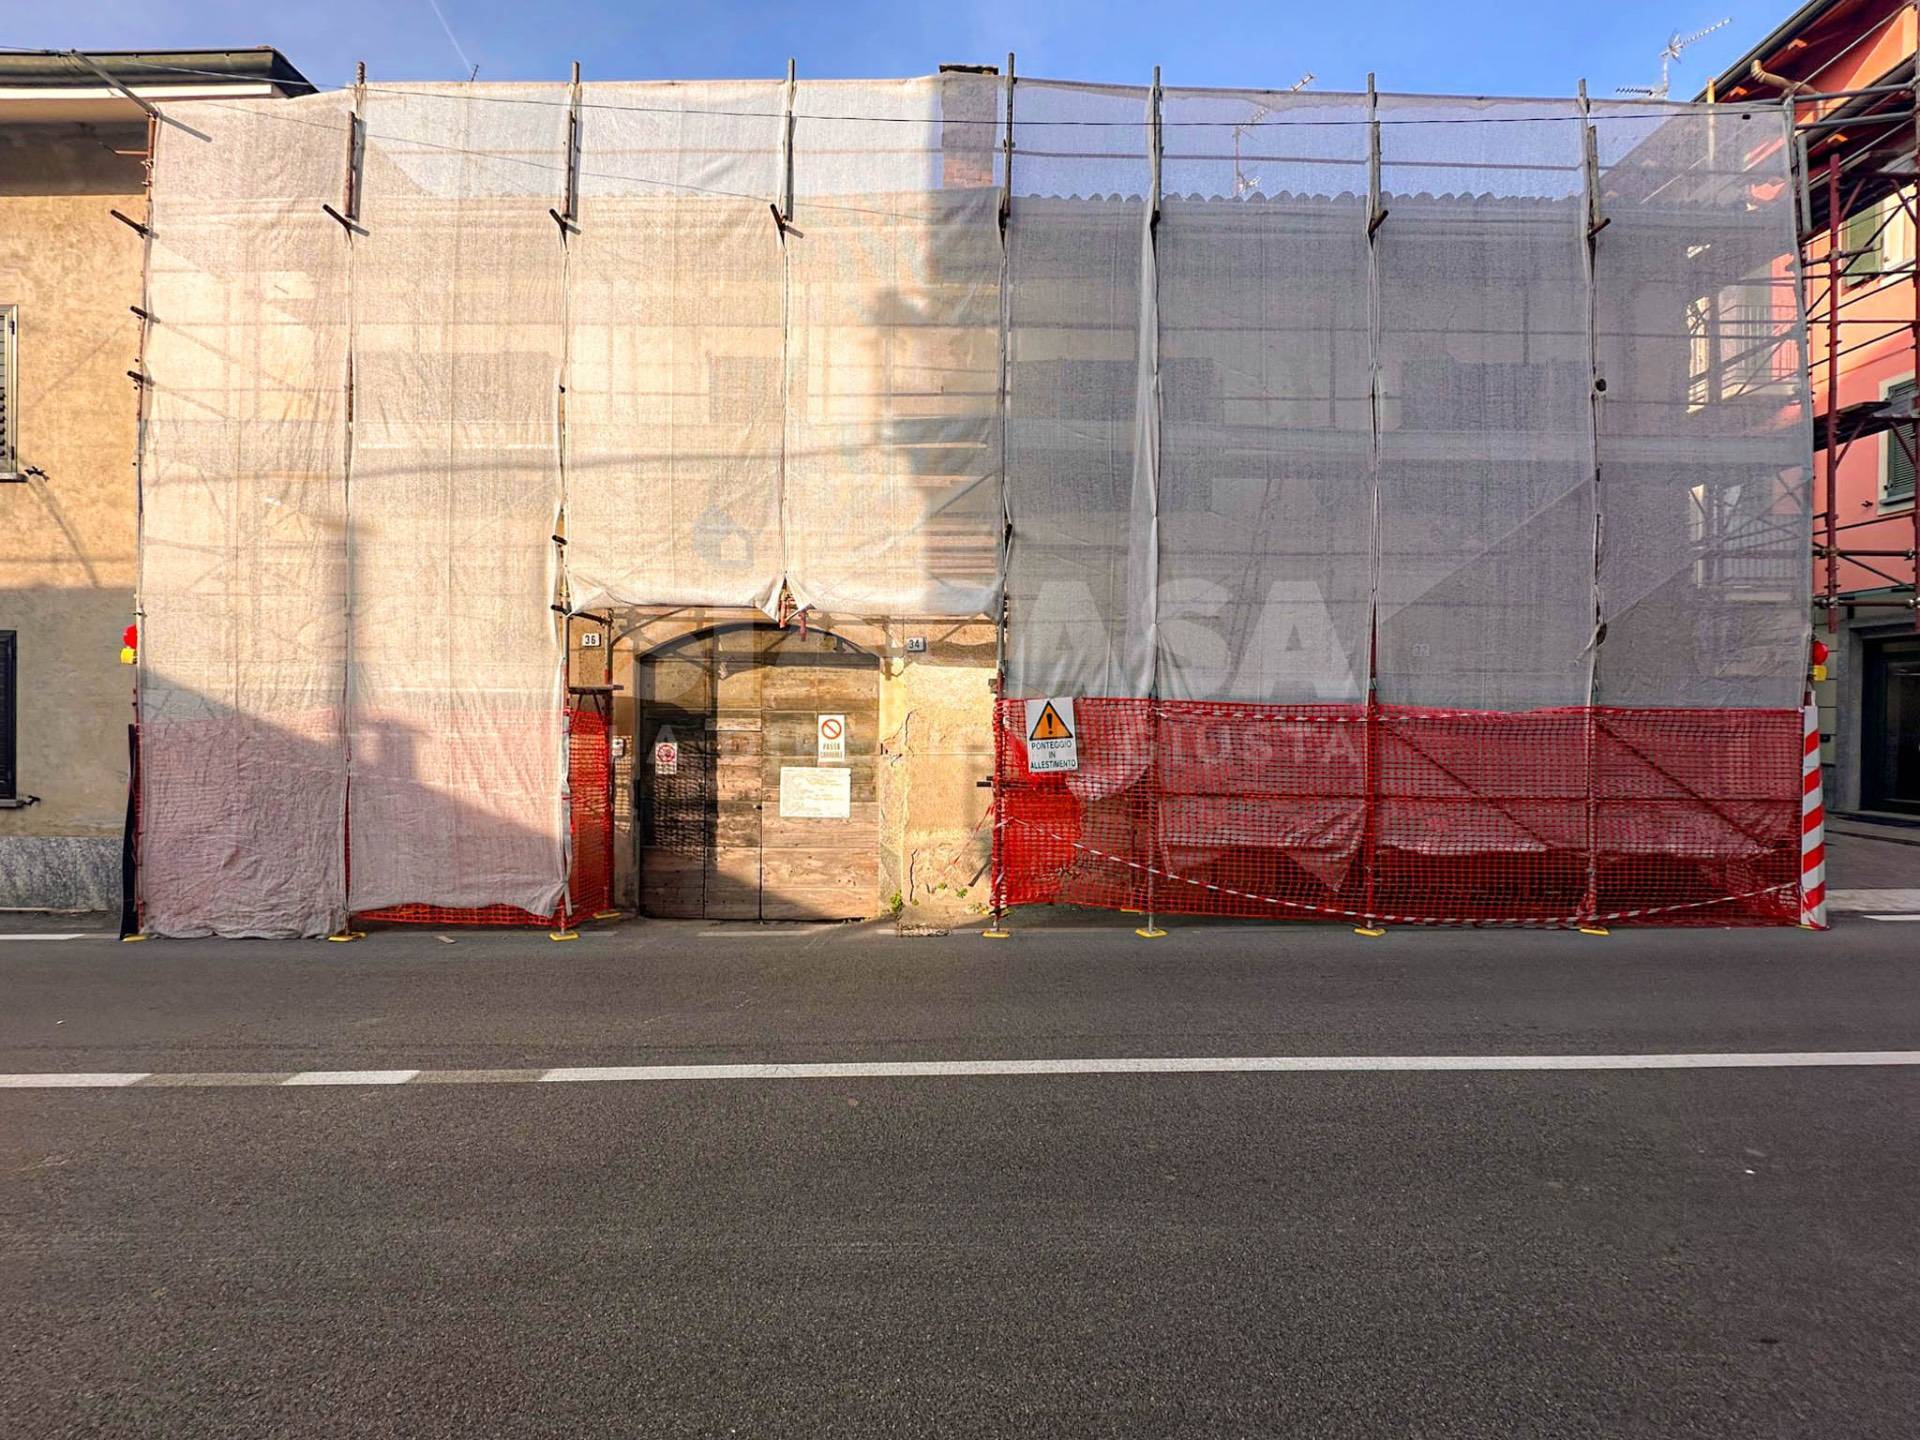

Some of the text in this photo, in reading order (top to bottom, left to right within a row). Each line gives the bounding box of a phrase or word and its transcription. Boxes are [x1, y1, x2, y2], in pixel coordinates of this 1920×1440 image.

[584, 634, 596, 645] 36
[908, 639, 920, 649] 34
[1031, 740, 1072, 750] PONTEGGIO
[1048, 751, 1056, 759] IN
[1030, 760, 1076, 769] ALLESTIMENTO
